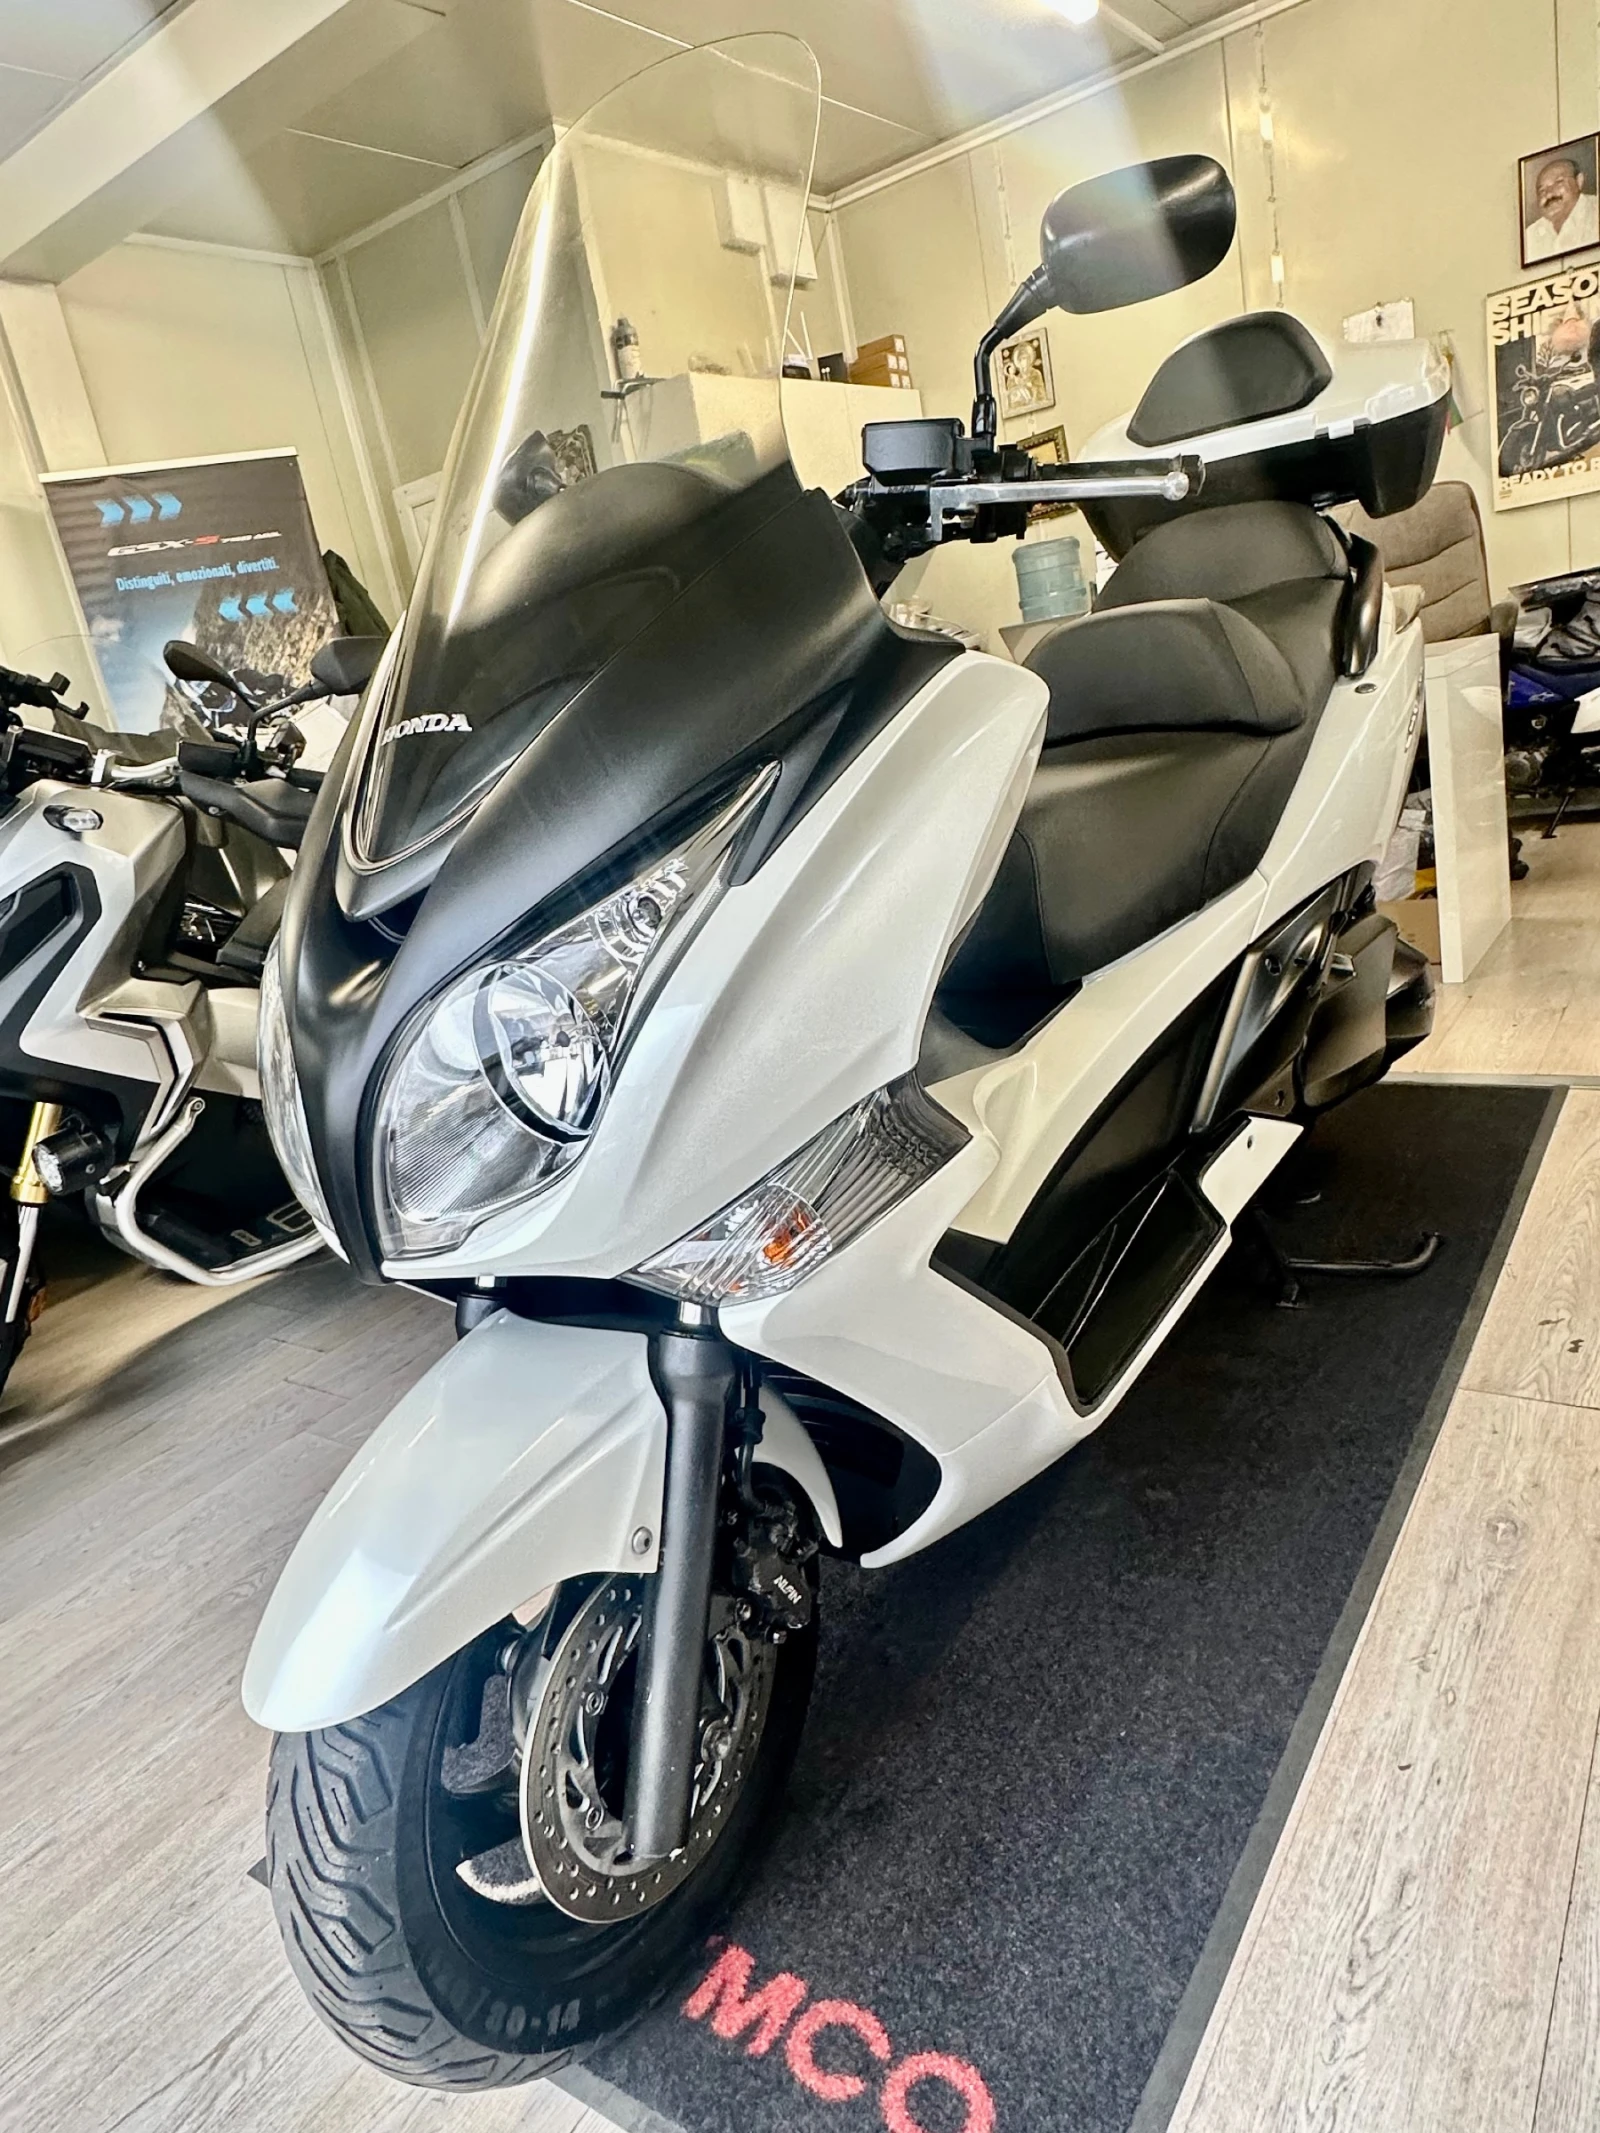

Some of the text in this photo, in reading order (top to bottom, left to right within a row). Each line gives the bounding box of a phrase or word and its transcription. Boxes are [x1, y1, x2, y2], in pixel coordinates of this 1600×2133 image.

[1491, 271, 1600, 321] SEASO
[1498, 466, 1558, 491] READY
[1560, 460, 1587, 476] TO
[115, 556, 280, 591] Distinguiti, emozionati, divertiti.
[381, 713, 473, 746] HONDA
[681, 1938, 997, 2133] MCO
